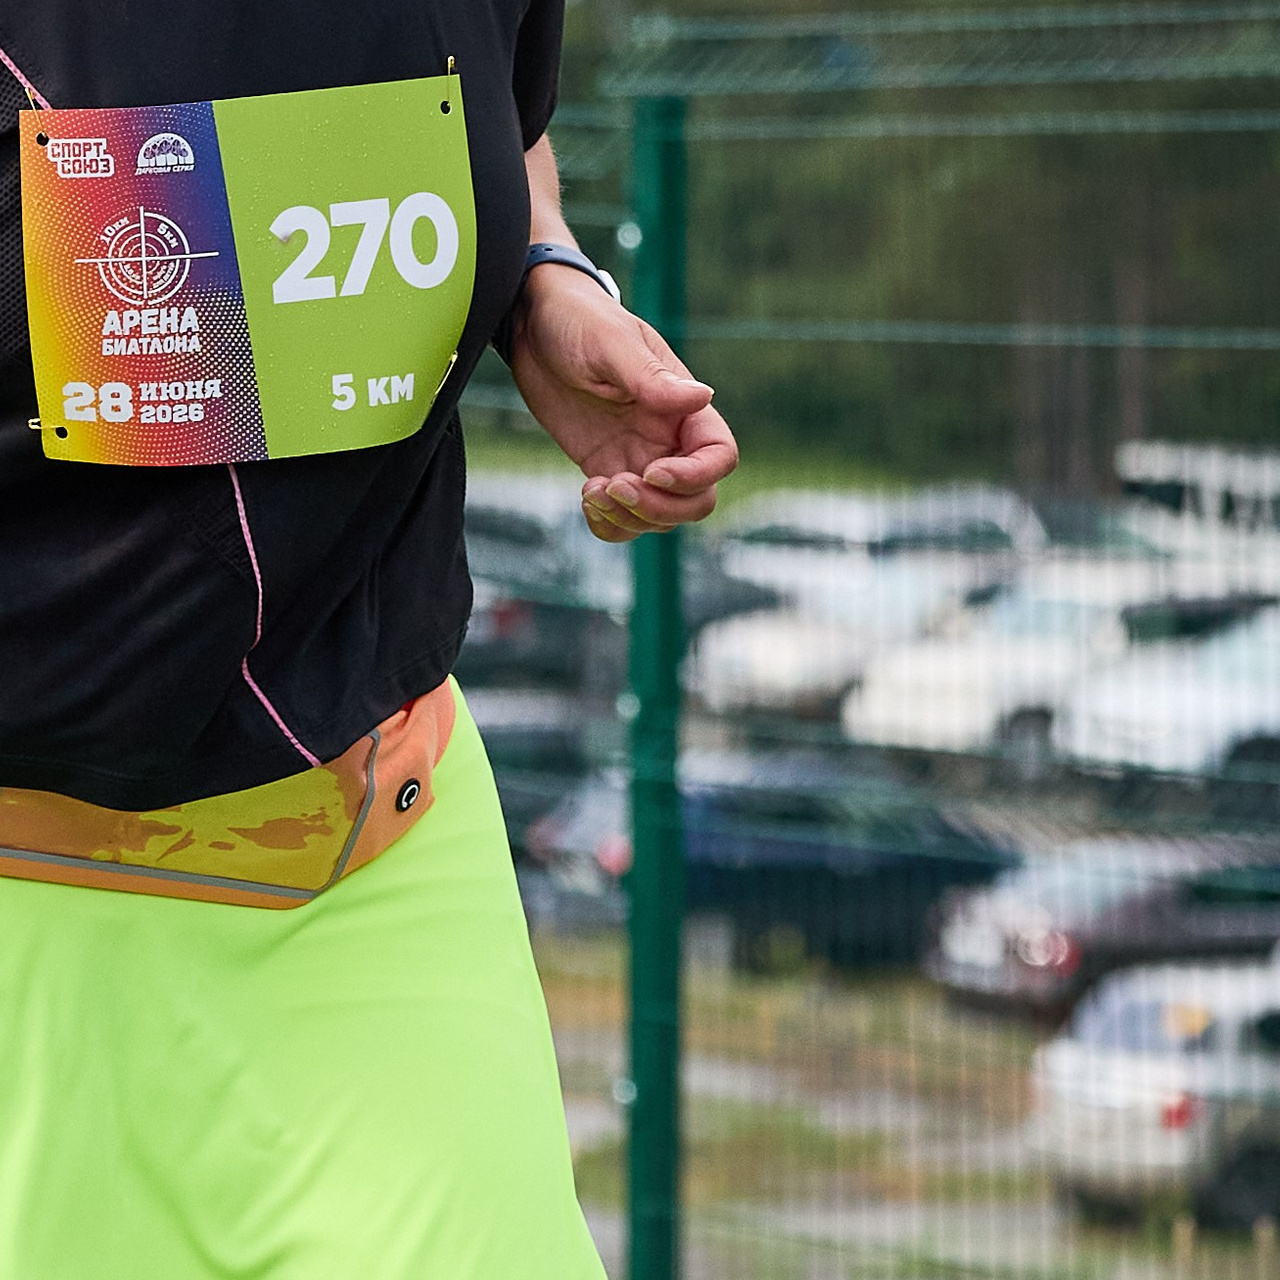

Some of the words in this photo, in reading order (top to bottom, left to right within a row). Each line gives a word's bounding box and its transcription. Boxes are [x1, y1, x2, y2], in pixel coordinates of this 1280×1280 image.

[50, 142, 103, 158] СПОРТ
[61, 158, 111, 175] СОЮЗ
[269, 191, 459, 304] 270
[101, 306, 199, 336] АРЕНА
[101, 334, 202, 356] БИАТЛОНА
[62, 381, 134, 423] 28
[139, 378, 222, 402] ИЮНЯ
[331, 373, 357, 410] 5
[367, 373, 415, 407] КМ
[140, 403, 205, 423] 2026
